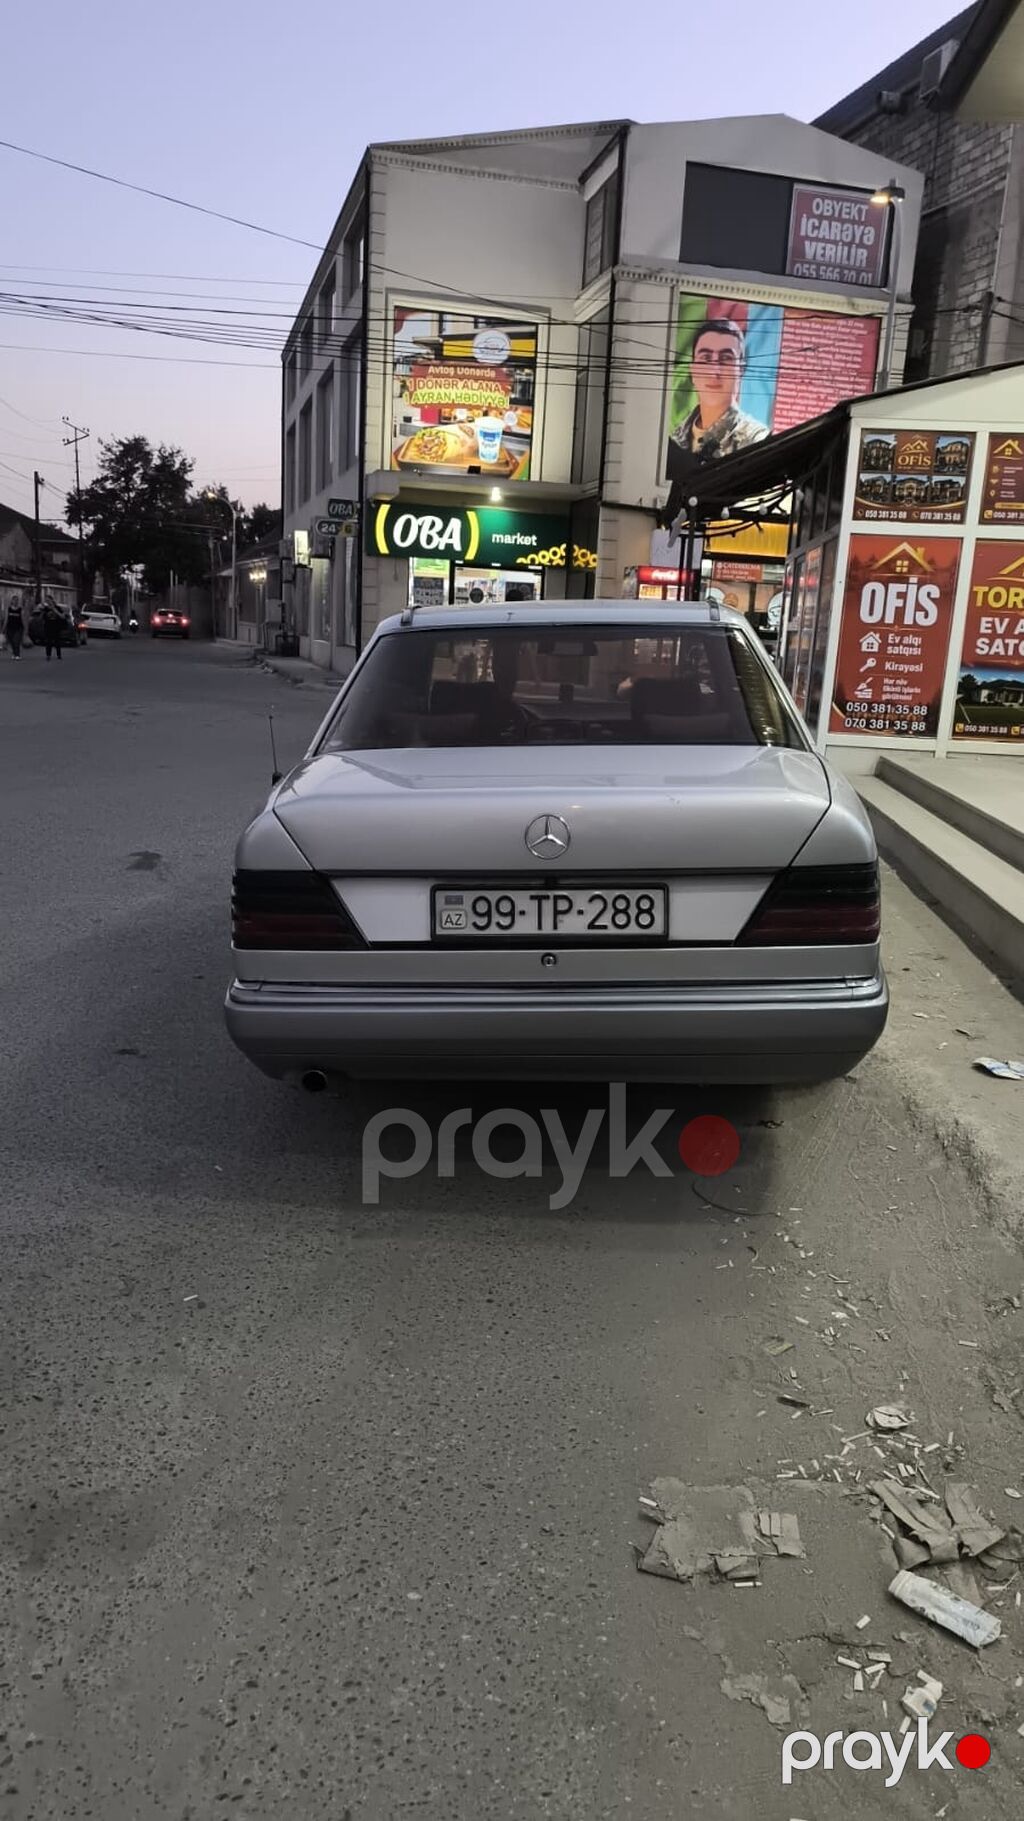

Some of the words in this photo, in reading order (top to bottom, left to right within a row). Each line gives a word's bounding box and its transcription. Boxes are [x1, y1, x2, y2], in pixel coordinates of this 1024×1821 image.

[812, 197, 868, 221] OBYEKT
[800, 214, 875, 245] İCARƏYƏ
[804, 239, 868, 267] VERİLİR
[412, 390, 452, 404] AYRAN
[898, 454, 931, 466] OFİS
[329, 502, 353, 515] OBA
[321, 523, 336, 533] 24
[393, 513, 463, 551] OBA
[492, 531, 537, 547] market
[860, 577, 941, 627] OFİS
[979, 616, 1010, 634] EV
[888, 633, 900, 644] Ev
[903, 635, 921, 646] alqı
[846, 702, 868, 712] 050
[871, 703, 891, 713] 381
[895, 704, 909, 714] 35
[913, 705, 928, 715] 88
[844, 718, 866, 728] 070
[869, 719, 889, 729] 381
[894, 720, 908, 730] 35
[911, 721, 926, 731] 88
[471, 893, 656, 931] 99-TP-288
[443, 914, 463, 926] AZ
